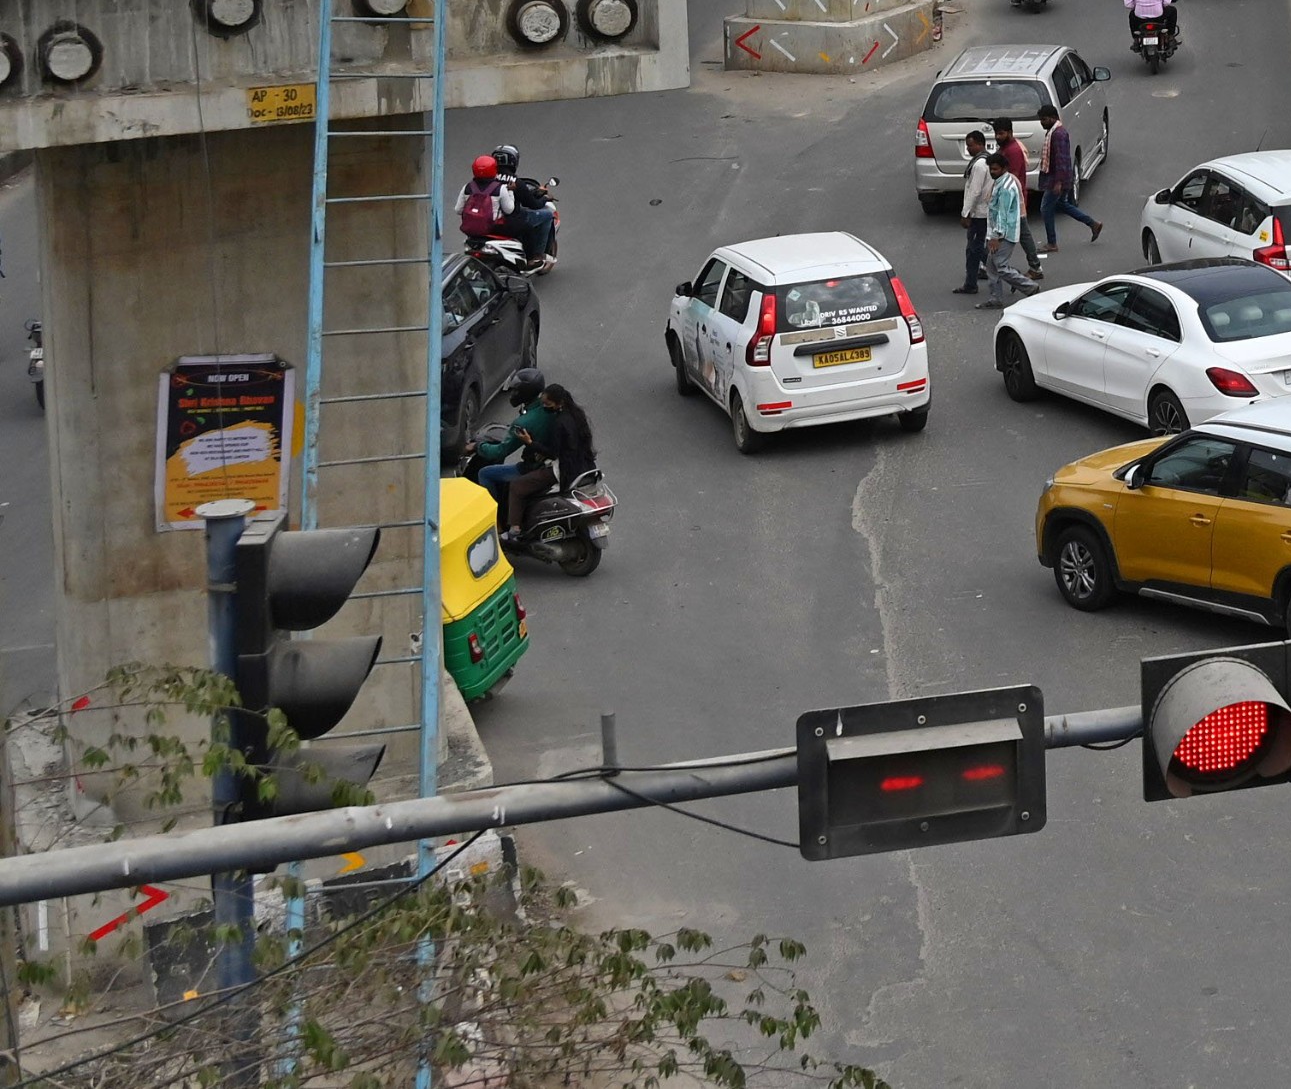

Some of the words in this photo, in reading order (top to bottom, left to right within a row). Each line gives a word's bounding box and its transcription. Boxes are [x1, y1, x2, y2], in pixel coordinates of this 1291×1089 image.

[252, 90, 267, 103] AP
[283, 89, 297, 102] 30
[849, 305, 878, 315] WANTED
[818, 349, 870, 365] KA05AL4389
[227, 373, 249, 382] OPEN
